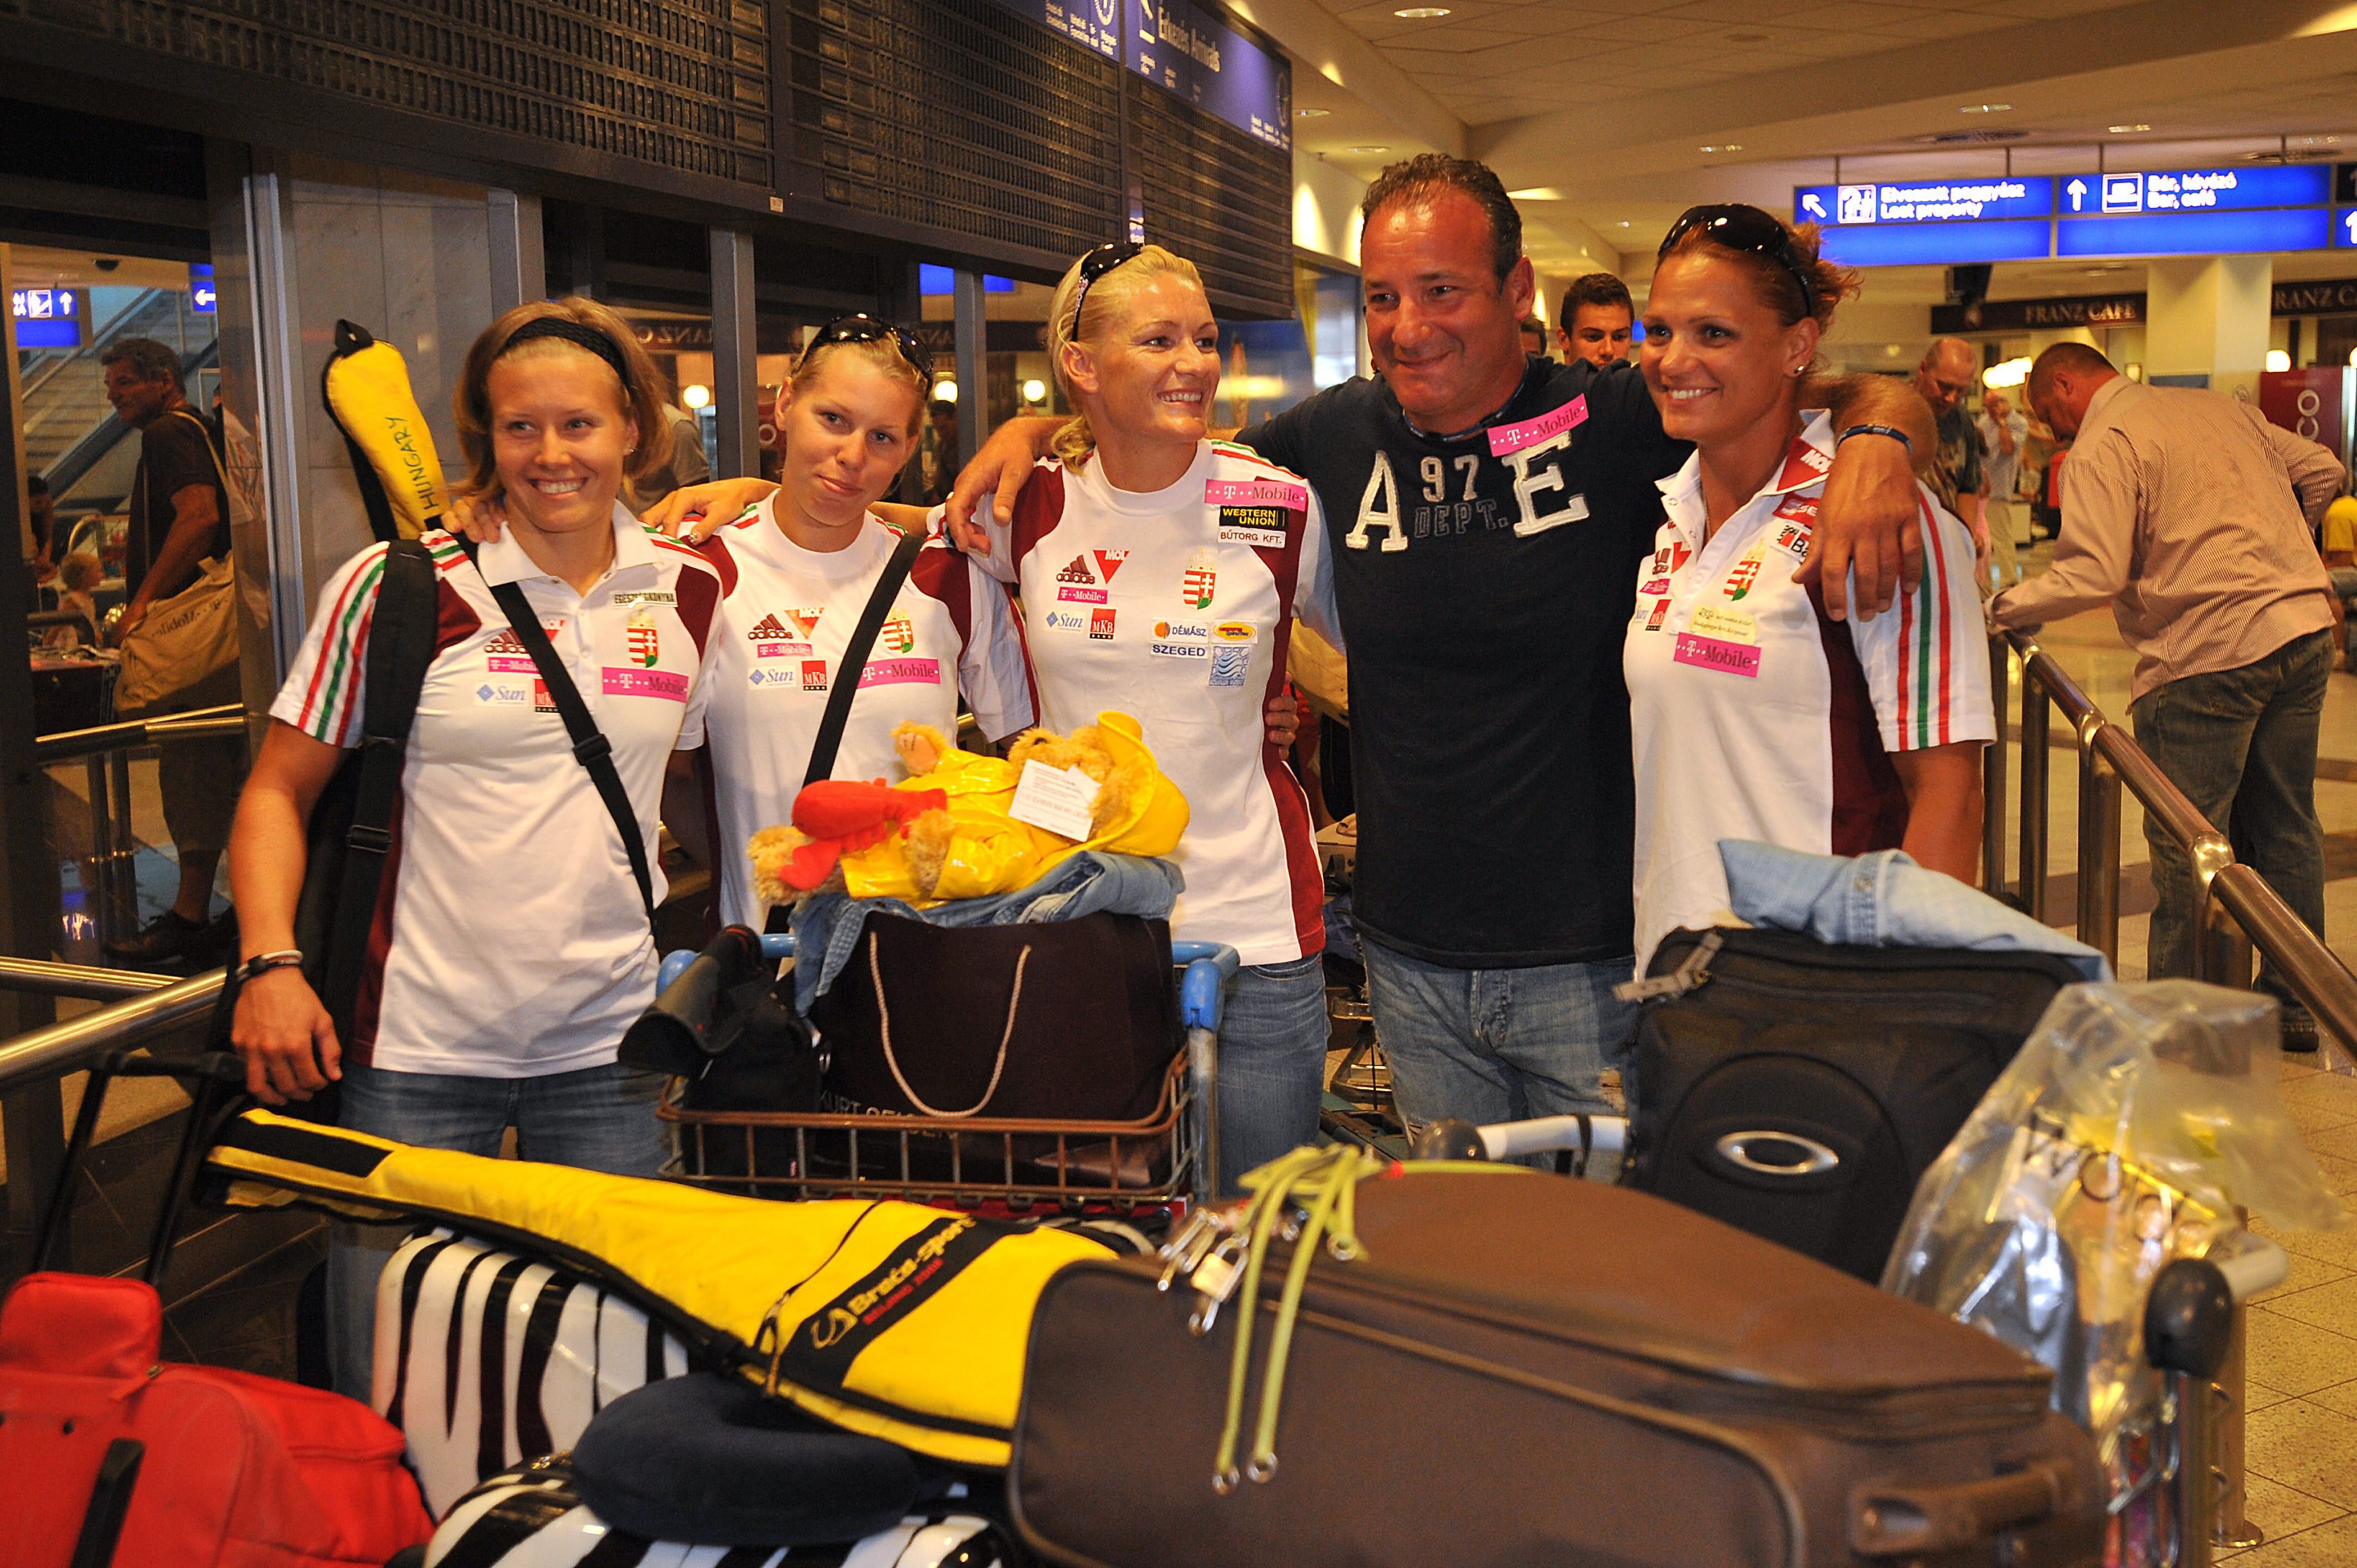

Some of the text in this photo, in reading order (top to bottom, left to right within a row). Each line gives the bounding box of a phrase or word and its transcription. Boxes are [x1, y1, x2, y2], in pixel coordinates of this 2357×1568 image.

[2025, 304, 2085, 324] FRANZ
[384, 416, 440, 511] HUNGARY
[1223, 508, 1276, 518] WESTERN
[1239, 517, 1275, 526] UNION
[1221, 529, 1258, 541] BÚTORG
[1105, 549, 1125, 560] MOL
[799, 607, 821, 618] MOL
[1058, 612, 1083, 628] Sun
[1092, 620, 1113, 633] MKB
[1172, 625, 1207, 637] DÉMÁSZ
[485, 641, 530, 654] adida
[1152, 644, 1206, 657] SZEGED
[766, 668, 794, 683] Sun
[804, 671, 827, 684] MKB
[496, 685, 526, 701] Sun
